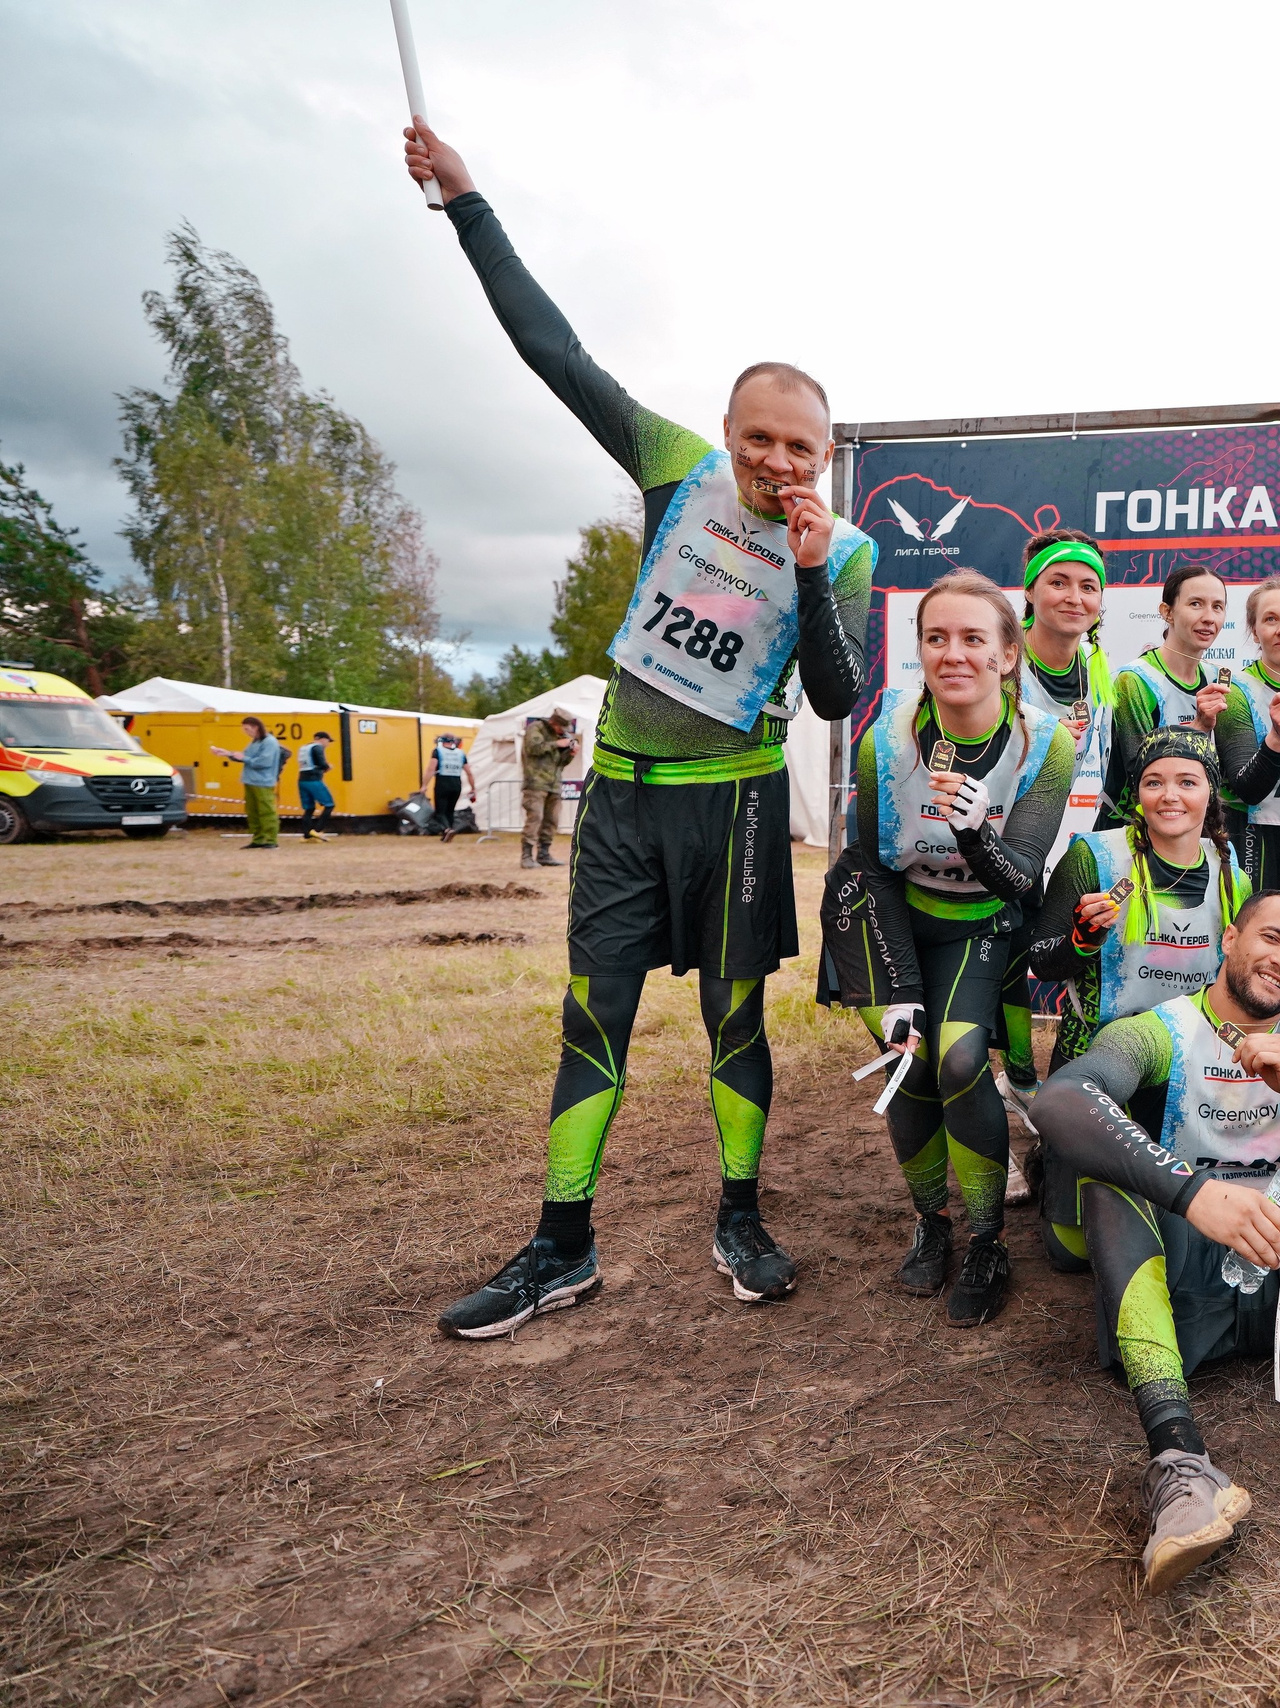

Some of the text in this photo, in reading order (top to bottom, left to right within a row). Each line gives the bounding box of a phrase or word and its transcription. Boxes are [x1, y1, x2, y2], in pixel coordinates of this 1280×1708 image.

[1095, 485, 1279, 533] ГОНКА
[705, 518, 786, 567] ГОНКА ГЕРОЕВ
[894, 546, 960, 557] ЛИГА ГЕРОЕВ
[678, 544, 759, 598] Greenway
[696, 572, 734, 594] GLOBAL
[1128, 612, 1162, 620] Greenwa
[642, 591, 744, 673] 7288
[654, 662, 704, 694] ГАЗПРОМБАНК
[741, 790, 760, 903] #ТыМожешьВсё
[914, 840, 957, 853] Gree
[1138, 965, 1209, 985] Greenway
[1203, 1066, 1243, 1079] ГОНКА
[1082, 1082, 1179, 1166] Greenway
[1198, 1103, 1280, 1123] Greenway
[1090, 1107, 1139, 1157] GLOBAL
[1222, 1169, 1271, 1180] ГАЗПРОМБАНК
